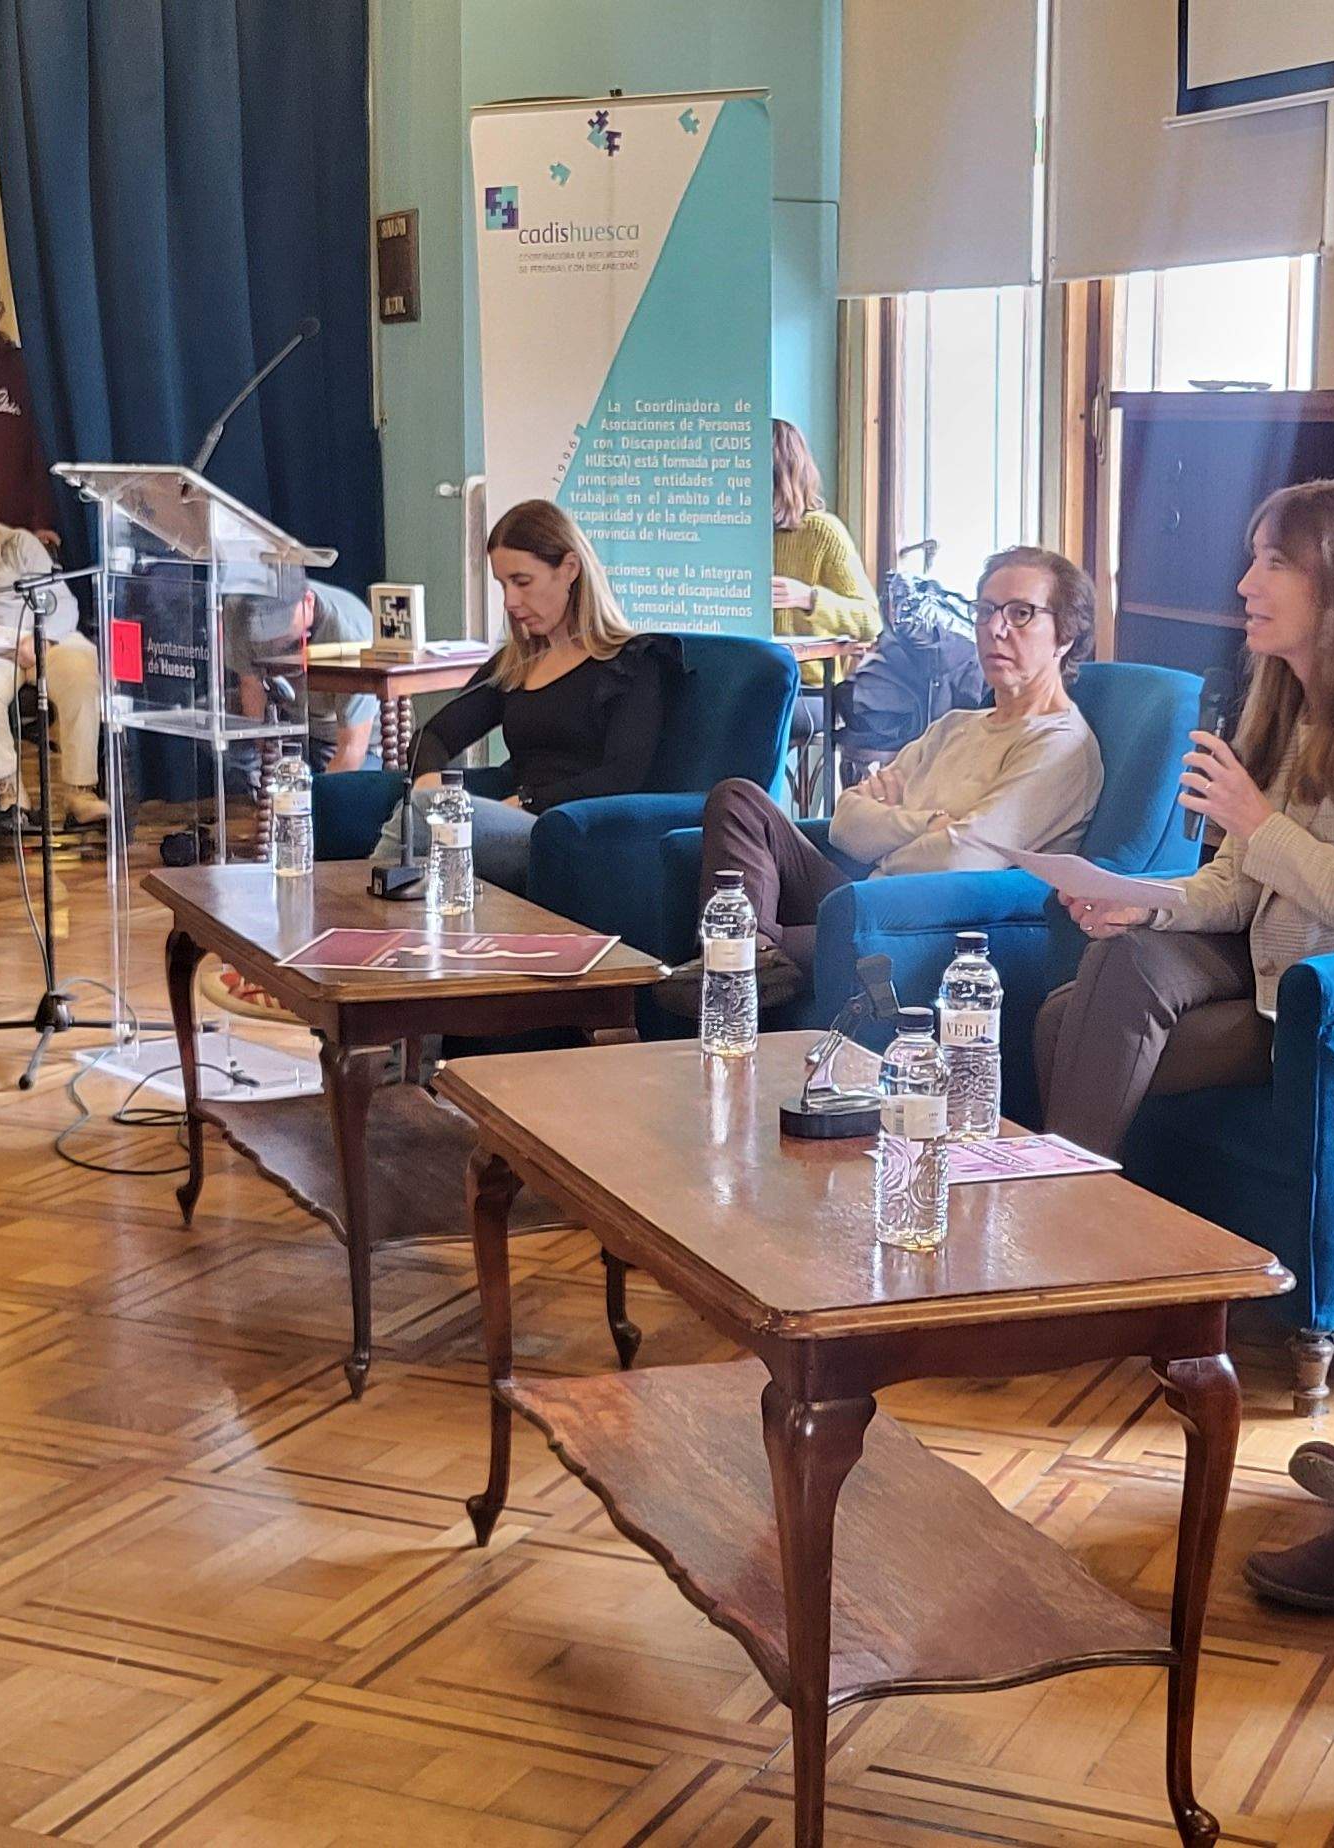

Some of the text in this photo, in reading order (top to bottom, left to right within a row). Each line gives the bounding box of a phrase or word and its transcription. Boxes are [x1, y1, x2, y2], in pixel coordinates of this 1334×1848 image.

[518, 221, 640, 245] cadishuesca
[608, 399, 751, 413] La Coordinadora de
[601, 418, 751, 431] Asociaciones de Personas
[593, 437, 751, 453] con Discapacidad (CADIS
[585, 454, 752, 473] HUESCA) está formada por las
[578, 472, 752, 491] principales entidades que
[570, 489, 620, 506] trabajan
[627, 493, 642, 504] en
[648, 491, 660, 505] el
[717, 491, 732, 506] de
[740, 491, 752, 506] la
[636, 512, 645, 526] y
[647, 508, 662, 523] de
[665, 509, 676, 523] la
[679, 510, 752, 527] dependencia
[639, 527, 654, 541] de
[657, 565, 679, 580] que
[685, 563, 696, 579] la
[701, 565, 752, 584] integran
[629, 582, 658, 597] tipos
[661, 581, 675, 597] de
[678, 583, 751, 600] discapacidad
[632, 601, 689, 616] sensorial,
[693, 603, 753, 618] trastornos
[147, 636, 210, 661] Ayuntamiento
[148, 657, 196, 679] de Huesca
